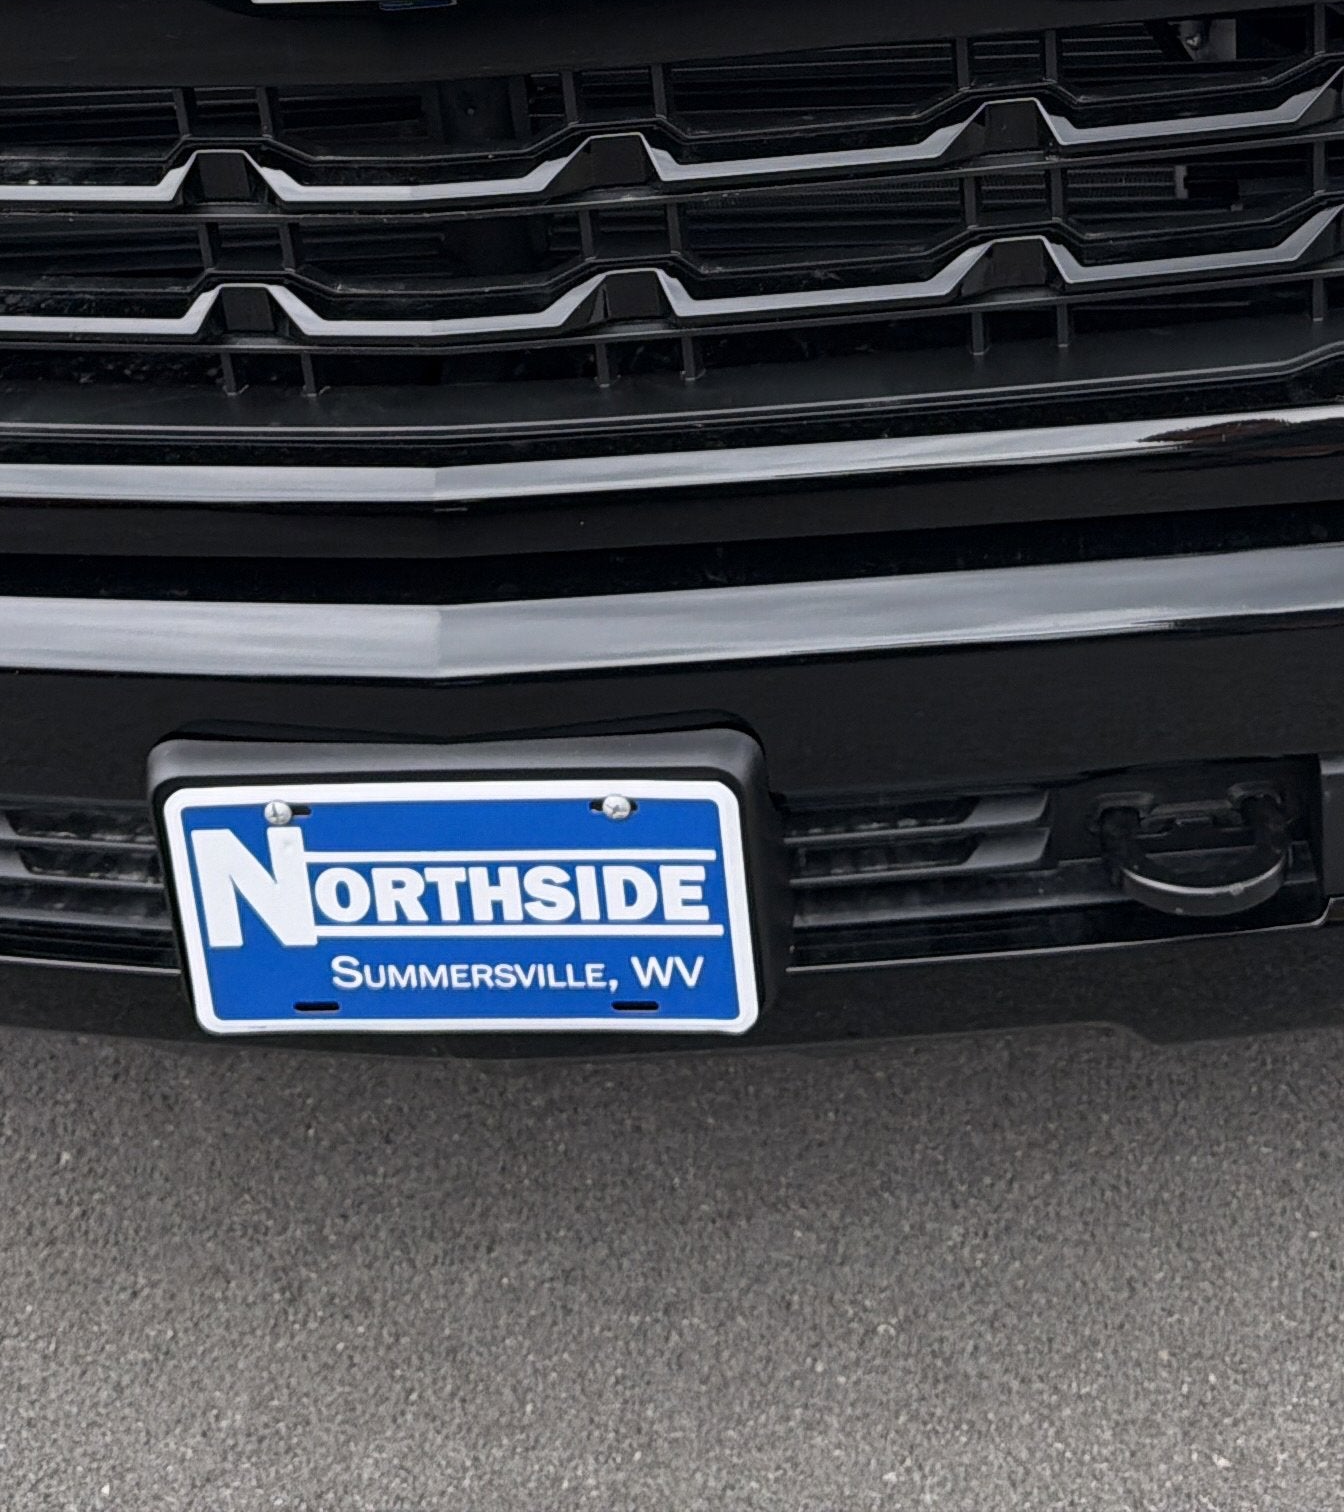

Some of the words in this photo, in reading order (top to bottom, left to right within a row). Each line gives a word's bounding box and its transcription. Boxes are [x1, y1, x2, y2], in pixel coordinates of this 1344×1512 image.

[191, 826, 710, 948] NORTHSIDE
[332, 954, 619, 993] SUMMERSVILLE,
[631, 955, 705, 988] WV
